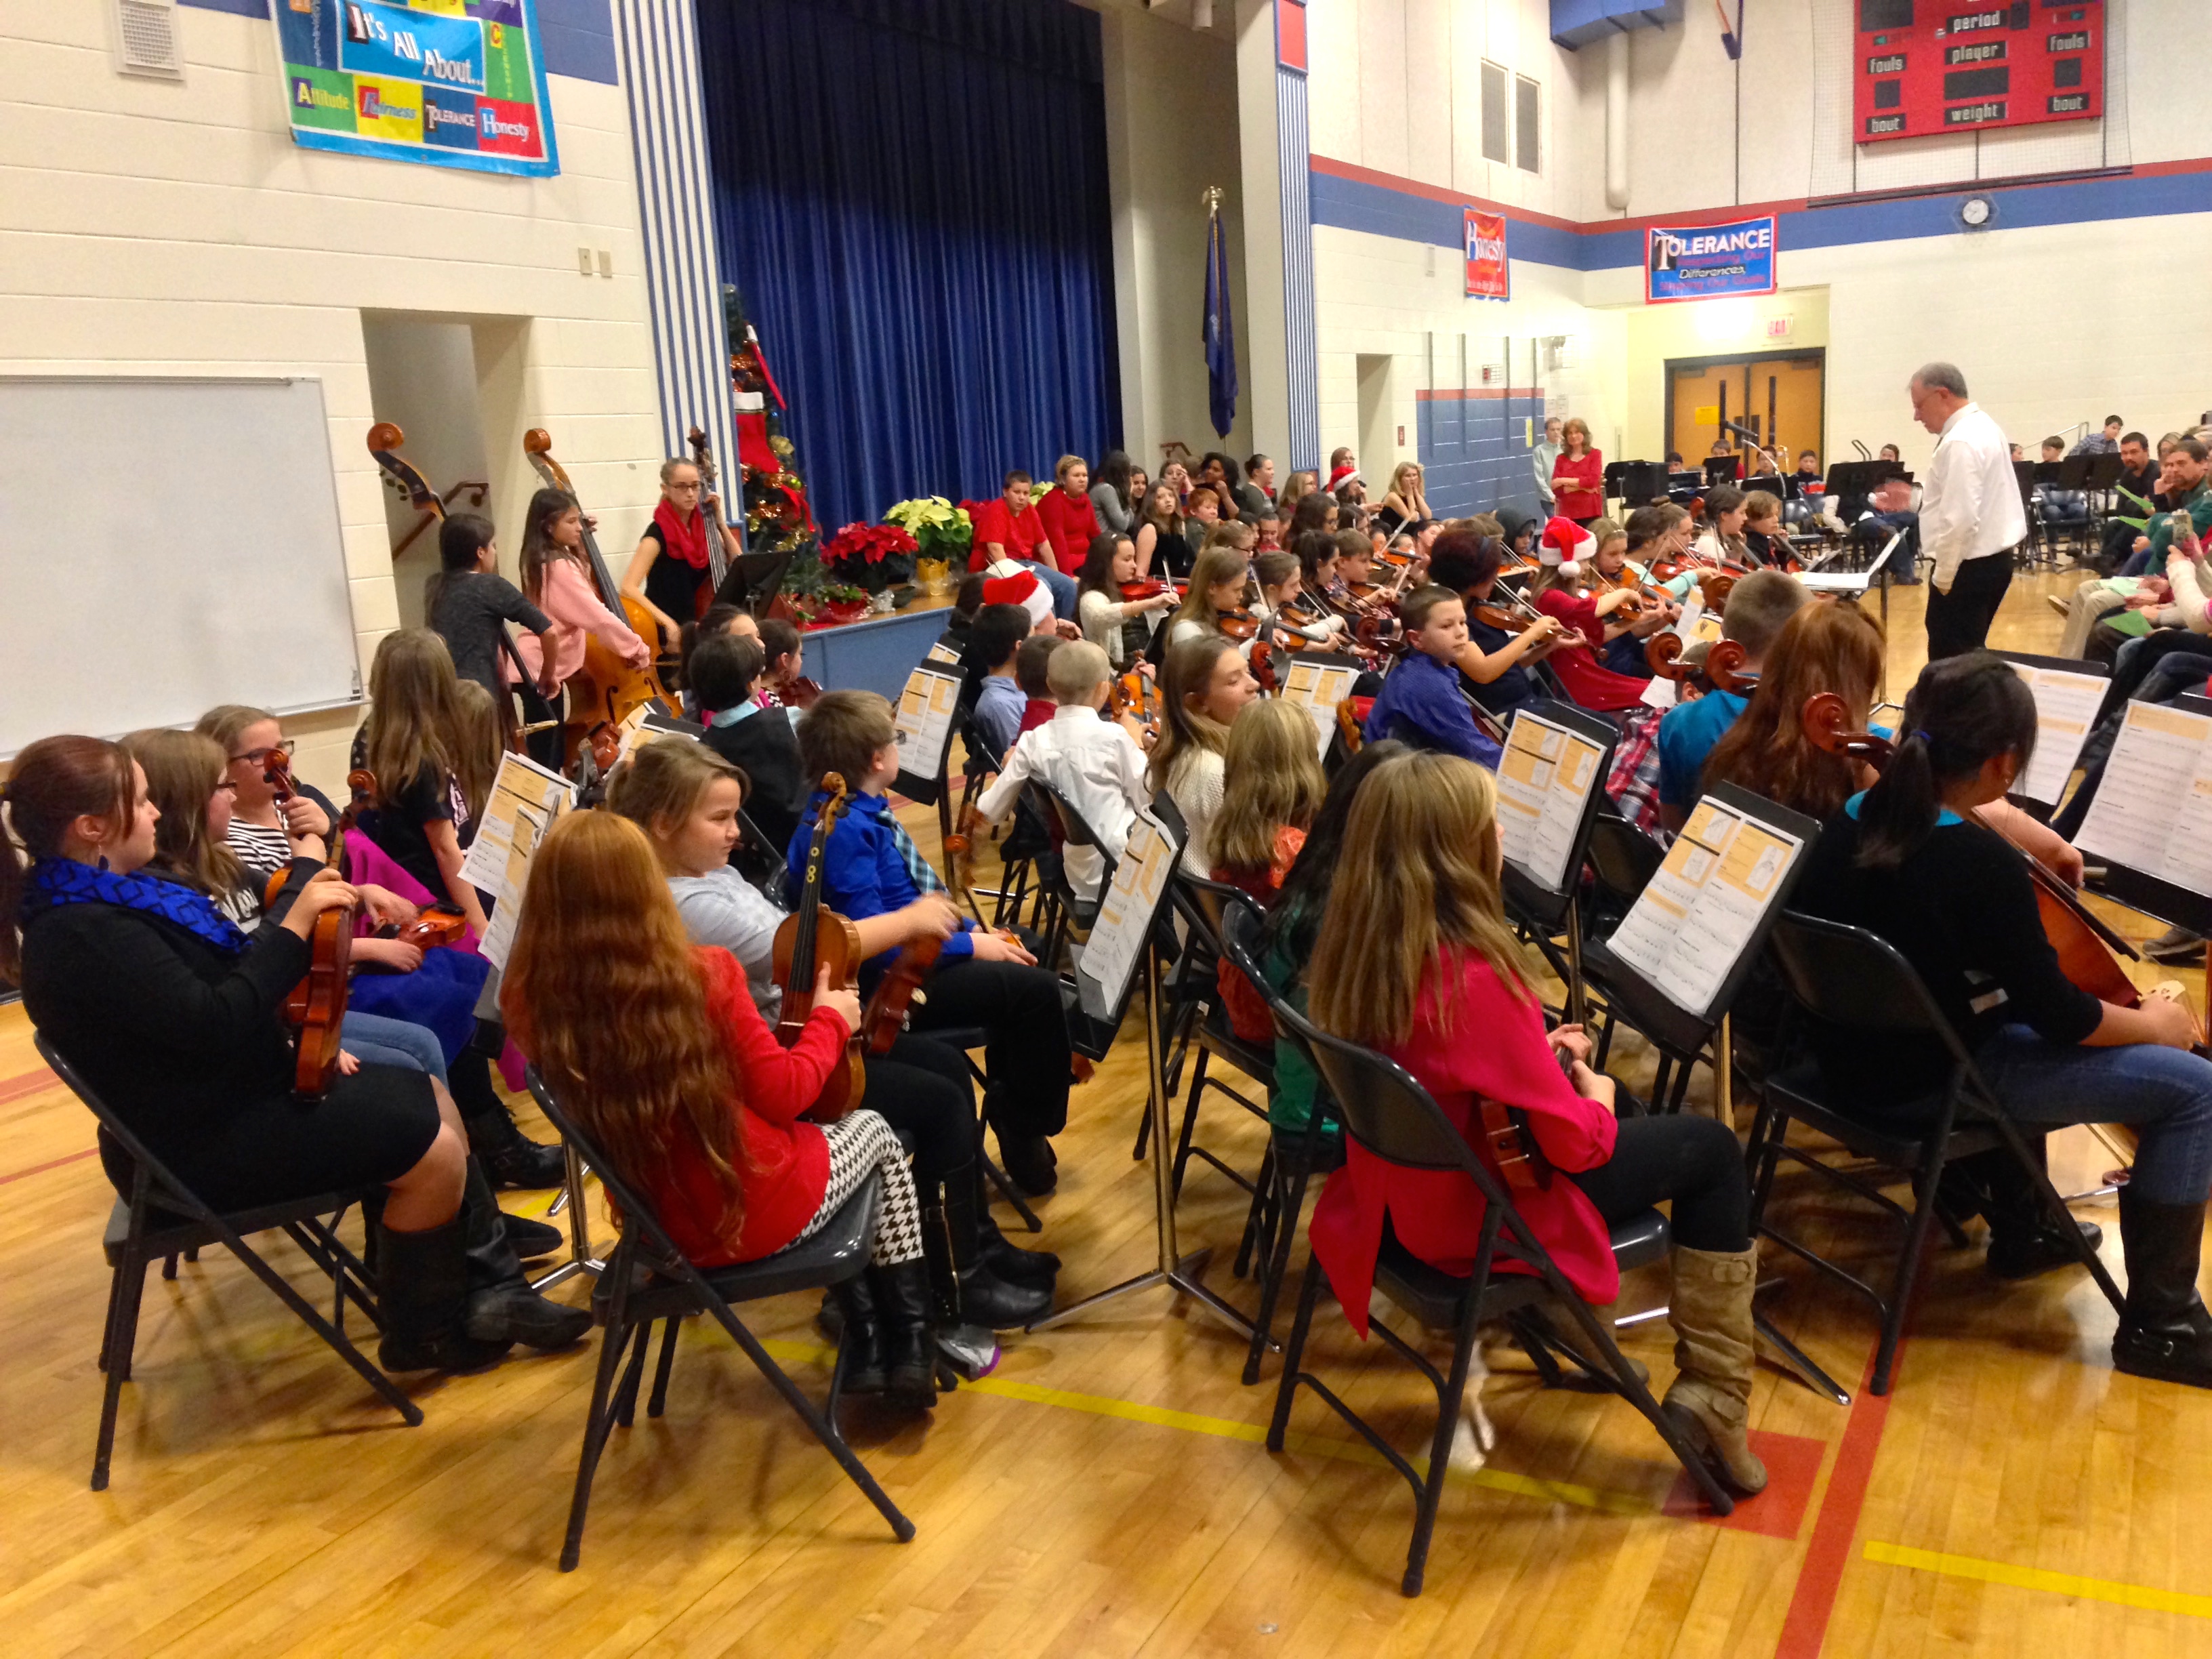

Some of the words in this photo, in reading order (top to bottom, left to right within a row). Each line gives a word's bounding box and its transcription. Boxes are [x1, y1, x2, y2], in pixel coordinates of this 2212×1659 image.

[1953, 10, 2001, 33] period
[351, 5, 387, 41] It's
[394, 32, 421, 60] All
[2050, 35, 2085, 51] fouls
[1870, 56, 1904, 74] fouls
[1952, 45, 1999, 64] player
[297, 82, 350, 110] Attitude
[363, 91, 417, 120] Fairness
[2053, 96, 2083, 112] bout
[1952, 104, 1999, 123] weight
[482, 112, 531, 142] Honesty
[1871, 117, 1900, 133] bout
[1467, 220, 1504, 272] Honesty
